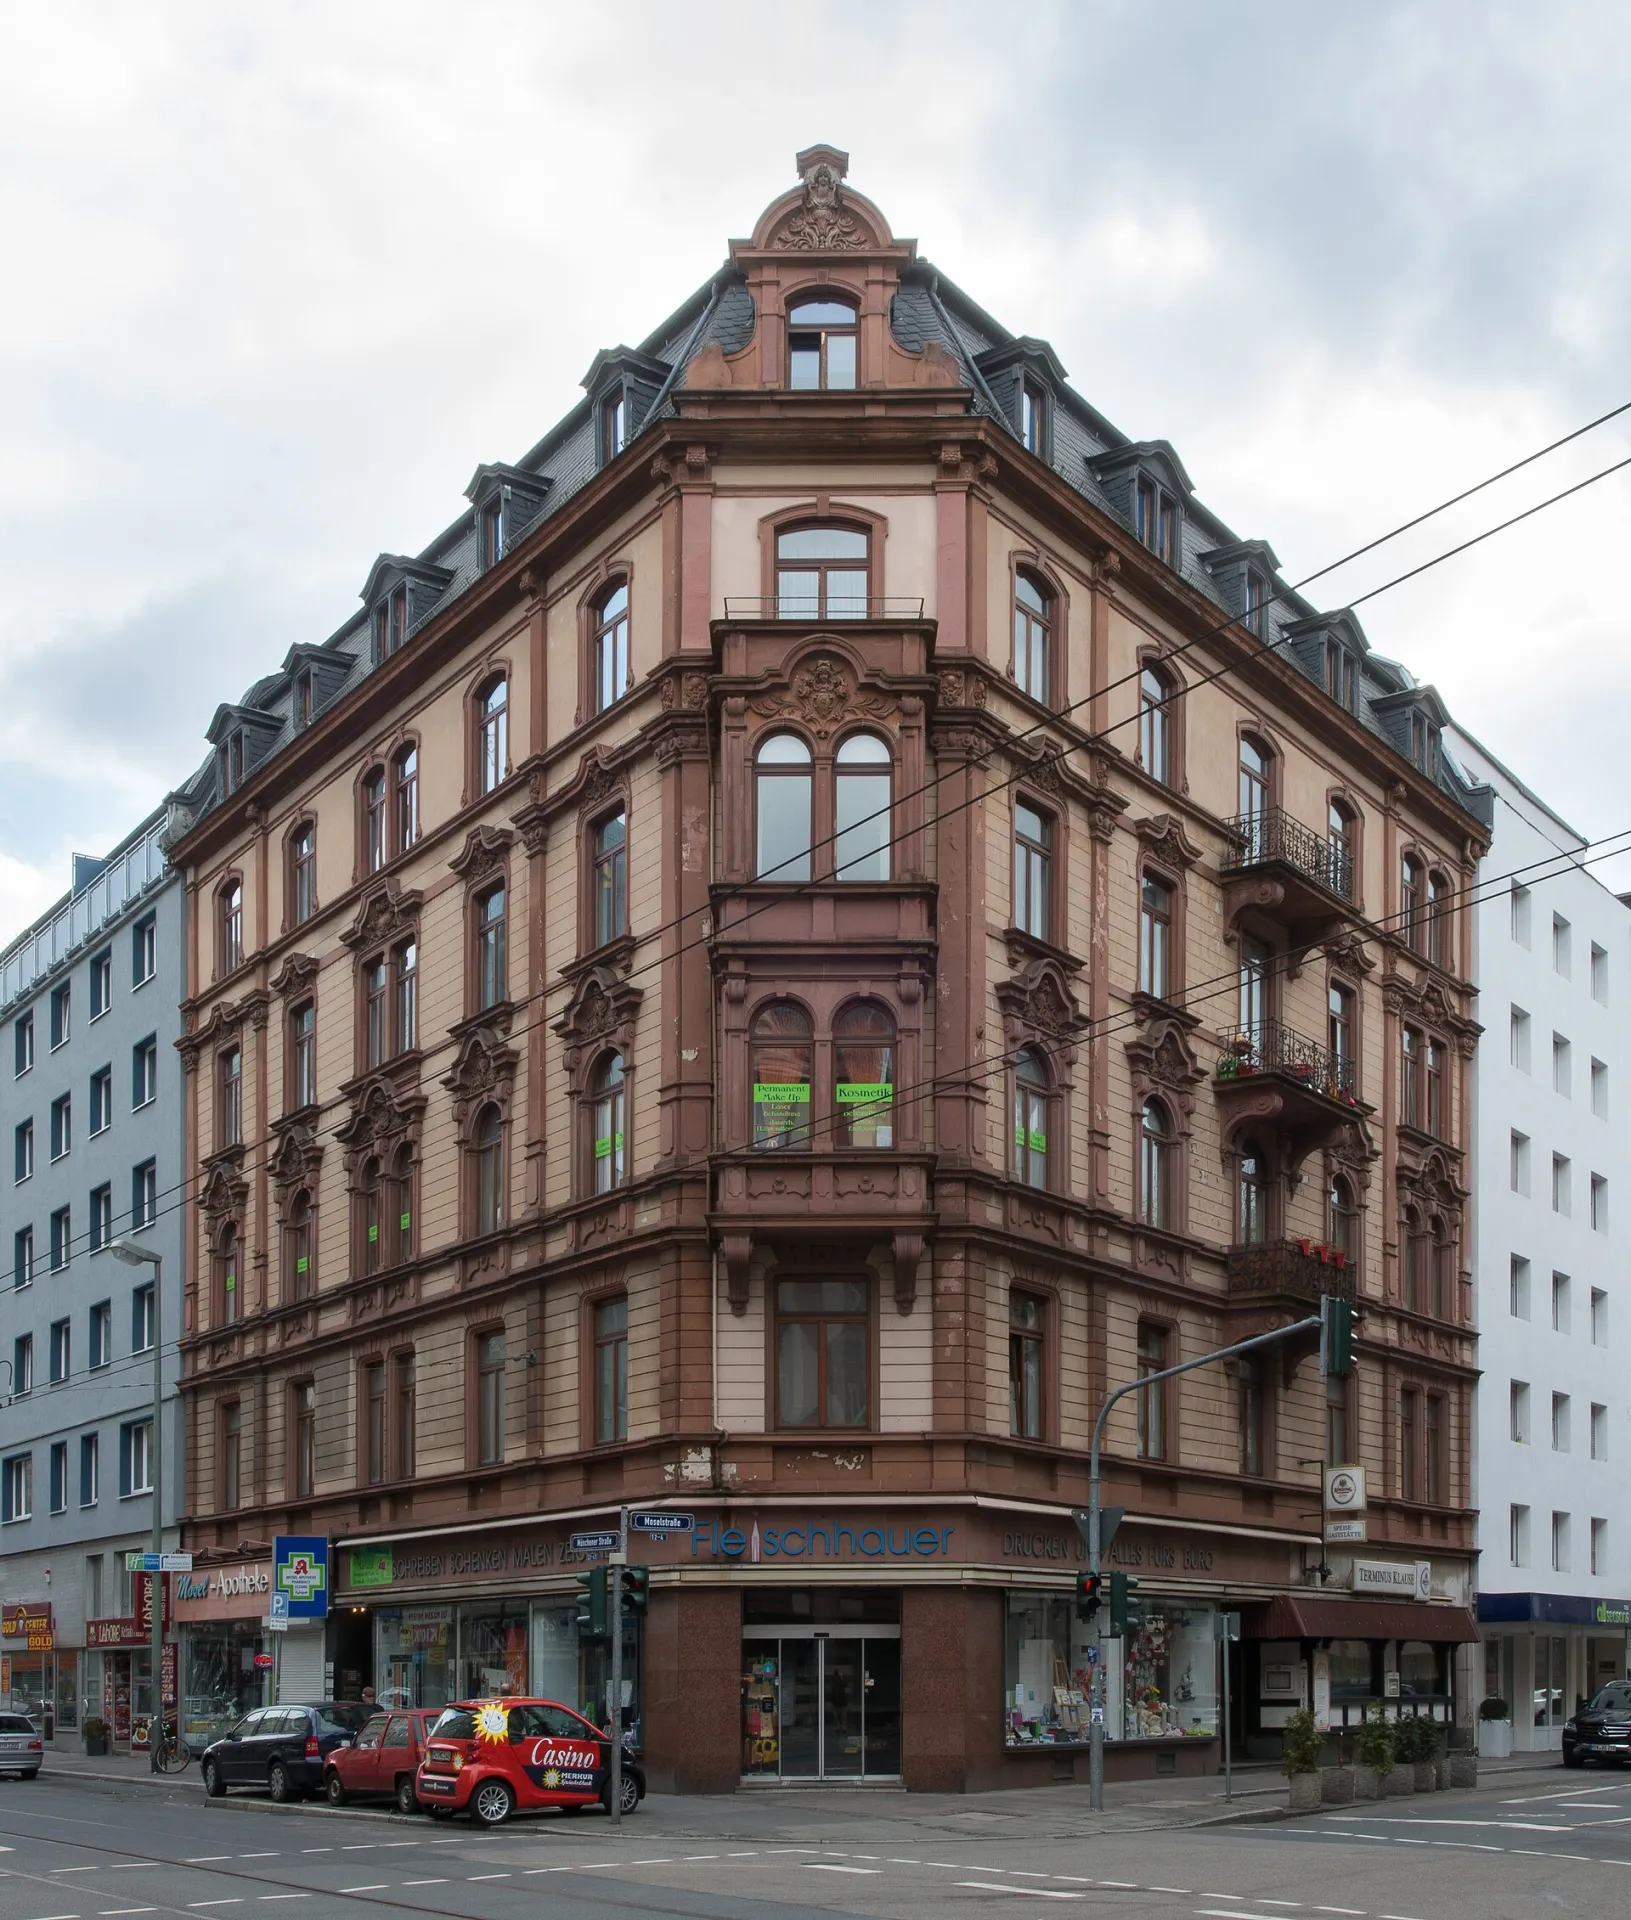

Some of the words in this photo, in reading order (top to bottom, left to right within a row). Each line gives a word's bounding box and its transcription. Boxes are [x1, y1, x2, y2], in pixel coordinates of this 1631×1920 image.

[788, 1094, 801, 1102] Up
[838, 1088, 891, 1097] Kosmetik
[644, 1516, 681, 1527] Moselstraße
[1327, 1531, 1362, 1539] GASTSTÄTTE
[577, 1538, 598, 1547] Münchener
[598, 1536, 612, 1545] Straße
[1003, 1532, 1068, 1560] DRUCKEN
[1110, 1541, 1143, 1566] ALLES
[392, 1556, 444, 1579] SCHREIBEN
[450, 1550, 507, 1574] SCHENKEN
[513, 1545, 555, 1568] MALEN
[1359, 1568, 1392, 1583] TERMINUS
[1393, 1571, 1414, 1586] KLAUSE
[2, 1620, 17, 1634] GOLD
[25, 1619, 47, 1632] CENTER
[29, 1636, 52, 1646] GOLD
[532, 1738, 594, 1768] Casino
[561, 1772, 593, 1781] MERKUR
